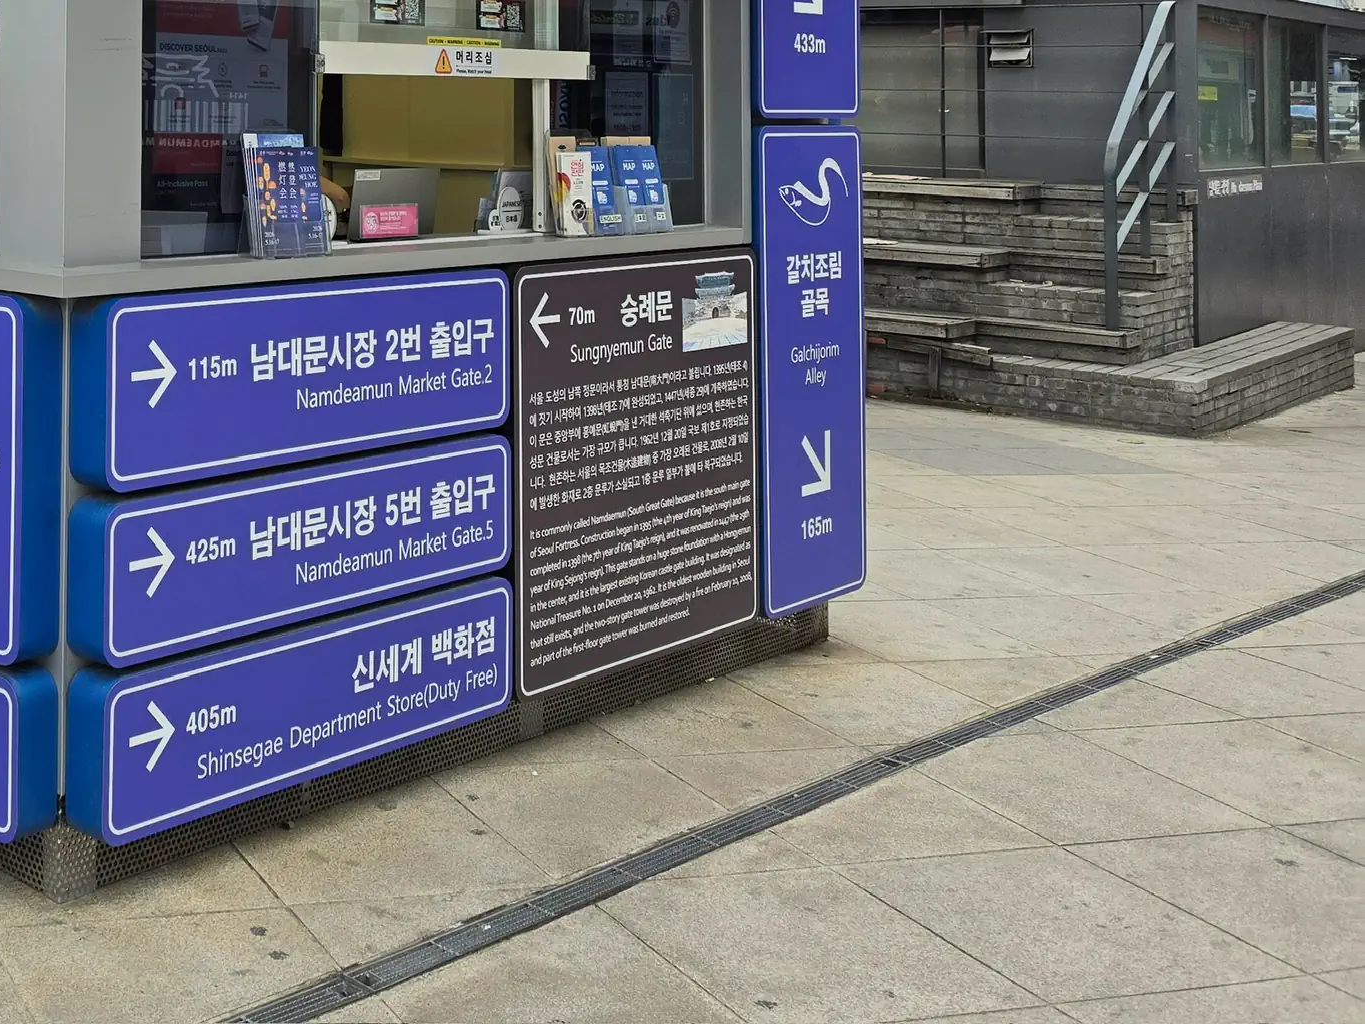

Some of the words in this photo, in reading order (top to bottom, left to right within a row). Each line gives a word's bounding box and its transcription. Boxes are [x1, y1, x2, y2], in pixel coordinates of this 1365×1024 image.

[159, 42, 194, 53] DISCOVER
[195, 43, 217, 53] SEOUL
[794, 33, 826, 55] 433m
[591, 162, 605, 172] MAP
[622, 162, 636, 171] MAP
[641, 162, 655, 171] MAP
[156, 180, 193, 188] All-Inclusive
[194, 179, 208, 187] Pass
[786, 249, 843, 285] 갈치조림
[568, 306, 596, 326] 70m
[620, 290, 674, 328] 숭례문
[800, 287, 831, 318] 골목
[188, 355, 238, 382] 115m
[250, 328, 378, 383] 남대문시장
[384, 323, 421, 363] 2번
[428, 317, 495, 361] 출입구
[570, 339, 645, 365] Sungnyemun
[647, 333, 673, 352] Gate
[790, 343, 841, 366] Galchijorim
[295, 378, 393, 411] Namdeamun
[398, 370, 447, 397] Market
[451, 363, 493, 390] Gate.2
[804, 368, 828, 387] Alley
[529, 453, 545, 471] 성문
[581, 443, 596, 460] 가장
[596, 438, 617, 457] 규모가
[185, 534, 236, 566] 425m
[249, 495, 378, 561] 남대문시장
[384, 485, 422, 527] 5번
[428, 473, 496, 521] 출입구
[540, 519, 573, 541] commonly
[573, 515, 590, 530] called
[704, 485, 713, 497] the
[800, 518, 833, 541] 165m
[295, 549, 393, 586] Namdeamun
[398, 535, 447, 562] Market
[451, 520, 495, 549] Gate.5
[351, 636, 423, 694] 신세계
[430, 615, 496, 666] 백화점
[185, 703, 238, 736] 405m
[196, 732, 284, 781] Shinsegae
[289, 702, 382, 750] Department
[386, 676, 461, 719] Store(Duty
[465, 663, 498, 692] Free)
